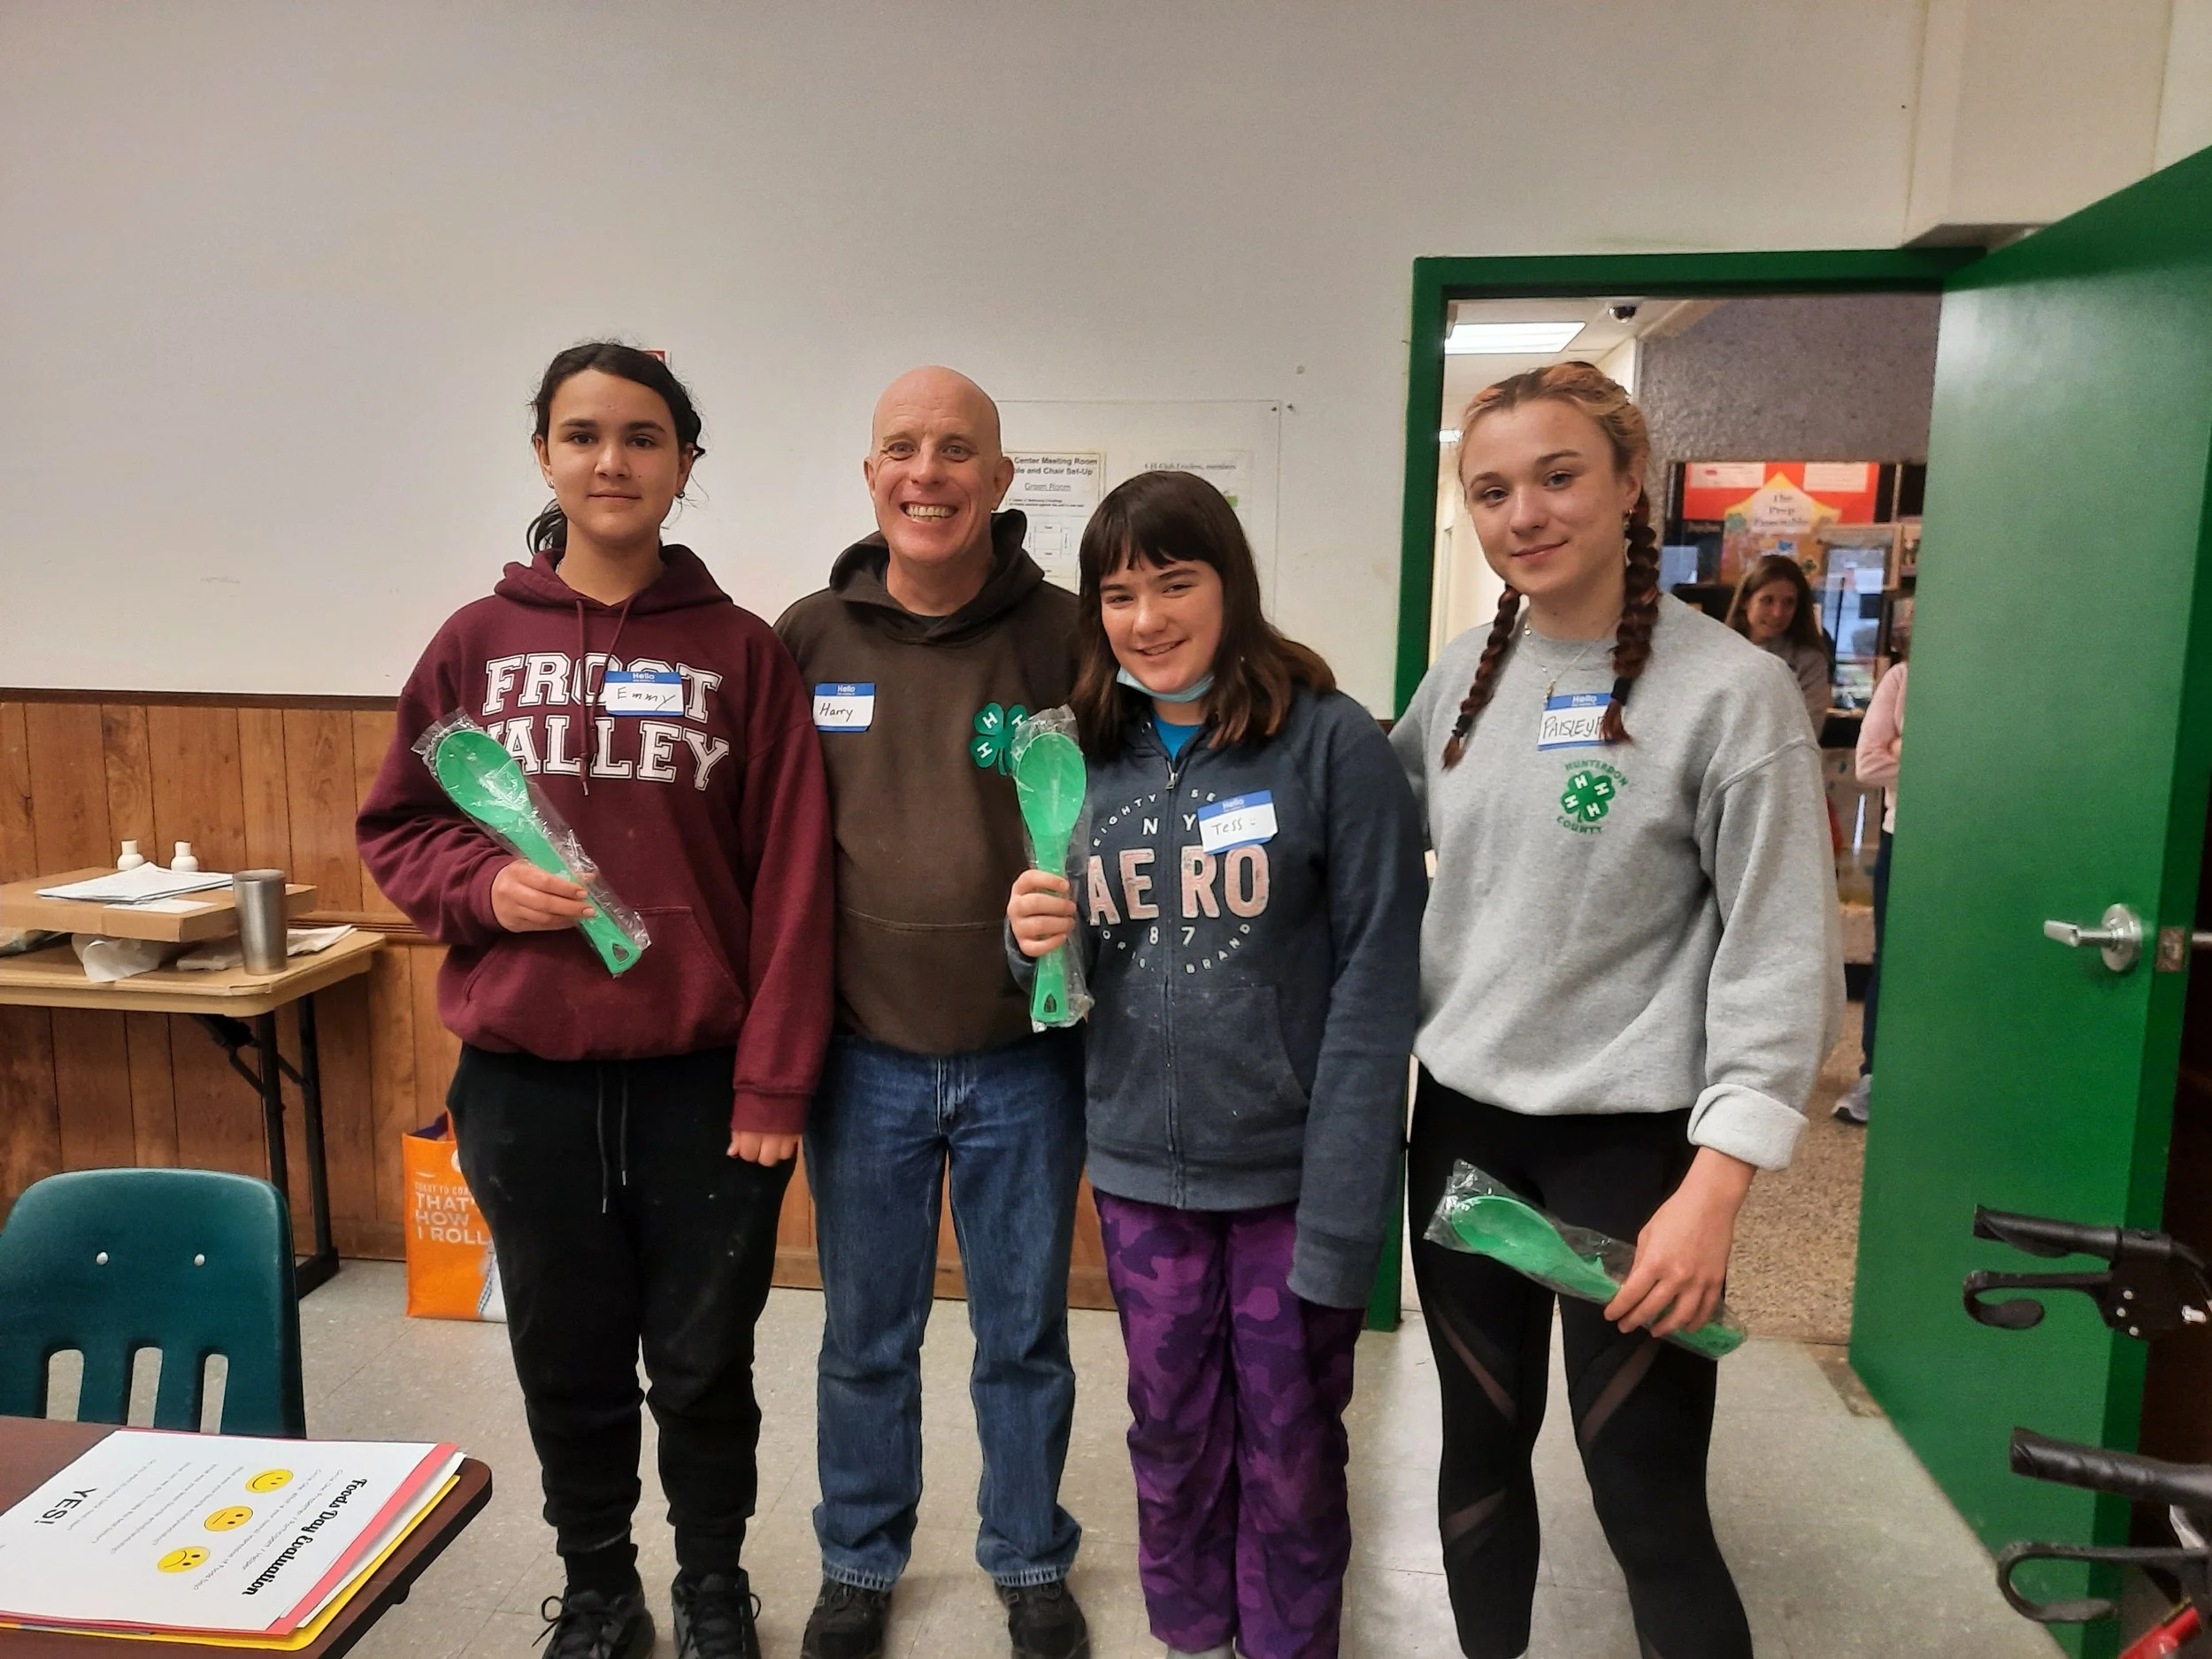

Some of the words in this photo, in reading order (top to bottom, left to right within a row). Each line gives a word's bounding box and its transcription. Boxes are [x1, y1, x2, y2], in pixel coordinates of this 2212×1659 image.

[1042, 457, 1072, 465] Meeting
[1066, 467, 1094, 476] Set-Up
[482, 652, 723, 724] FROT
[837, 684, 856, 693] Hello
[1572, 694, 1598, 703] Hello
[819, 703, 854, 723] Harry
[1565, 759, 1627, 787] HUNTERDON
[1222, 796, 1246, 810] Hello
[1093, 793, 1156, 848] EIGHTY
[1210, 818, 1243, 836] Tess
[1087, 844, 1270, 926] AERO
[1186, 924, 1250, 973] BRAND
[452, 1186, 470, 1196] COA
[416, 1192, 476, 1212] THAT'
[415, 1210, 470, 1227] HOW
[418, 1225, 423, 1240] I
[431, 1226, 488, 1246] ROLL
[329, 1479, 367, 1508] Foods
[35, 1489, 96, 1524] YES!
[301, 1510, 337, 1532] Day
[242, 1536, 313, 1594] Evaluation
